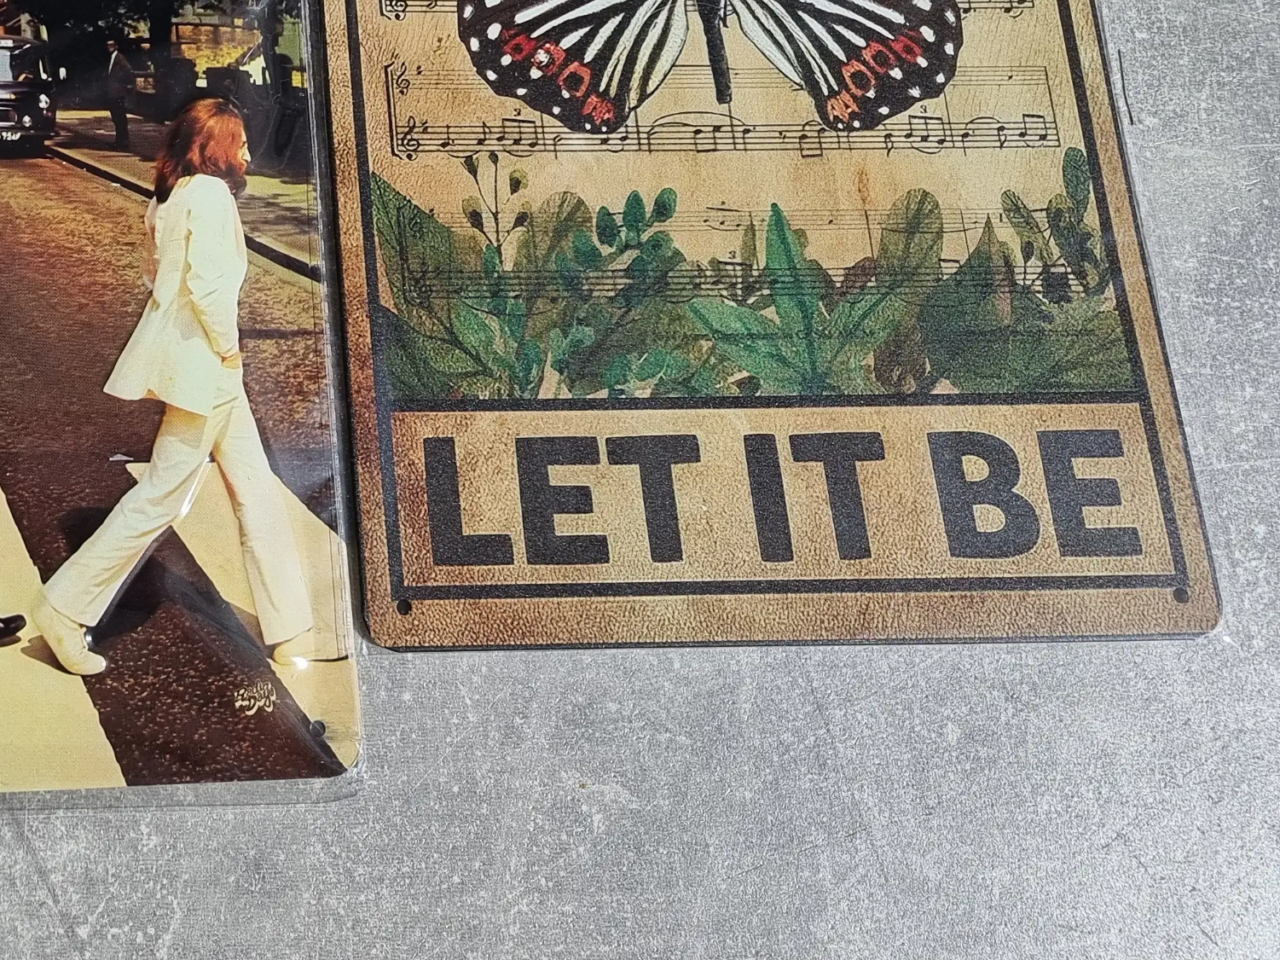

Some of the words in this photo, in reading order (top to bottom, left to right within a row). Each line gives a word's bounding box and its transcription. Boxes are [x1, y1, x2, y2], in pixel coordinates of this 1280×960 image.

[422, 434, 702, 567] LET
[744, 431, 886, 564] IT
[926, 429, 1143, 559] BE
